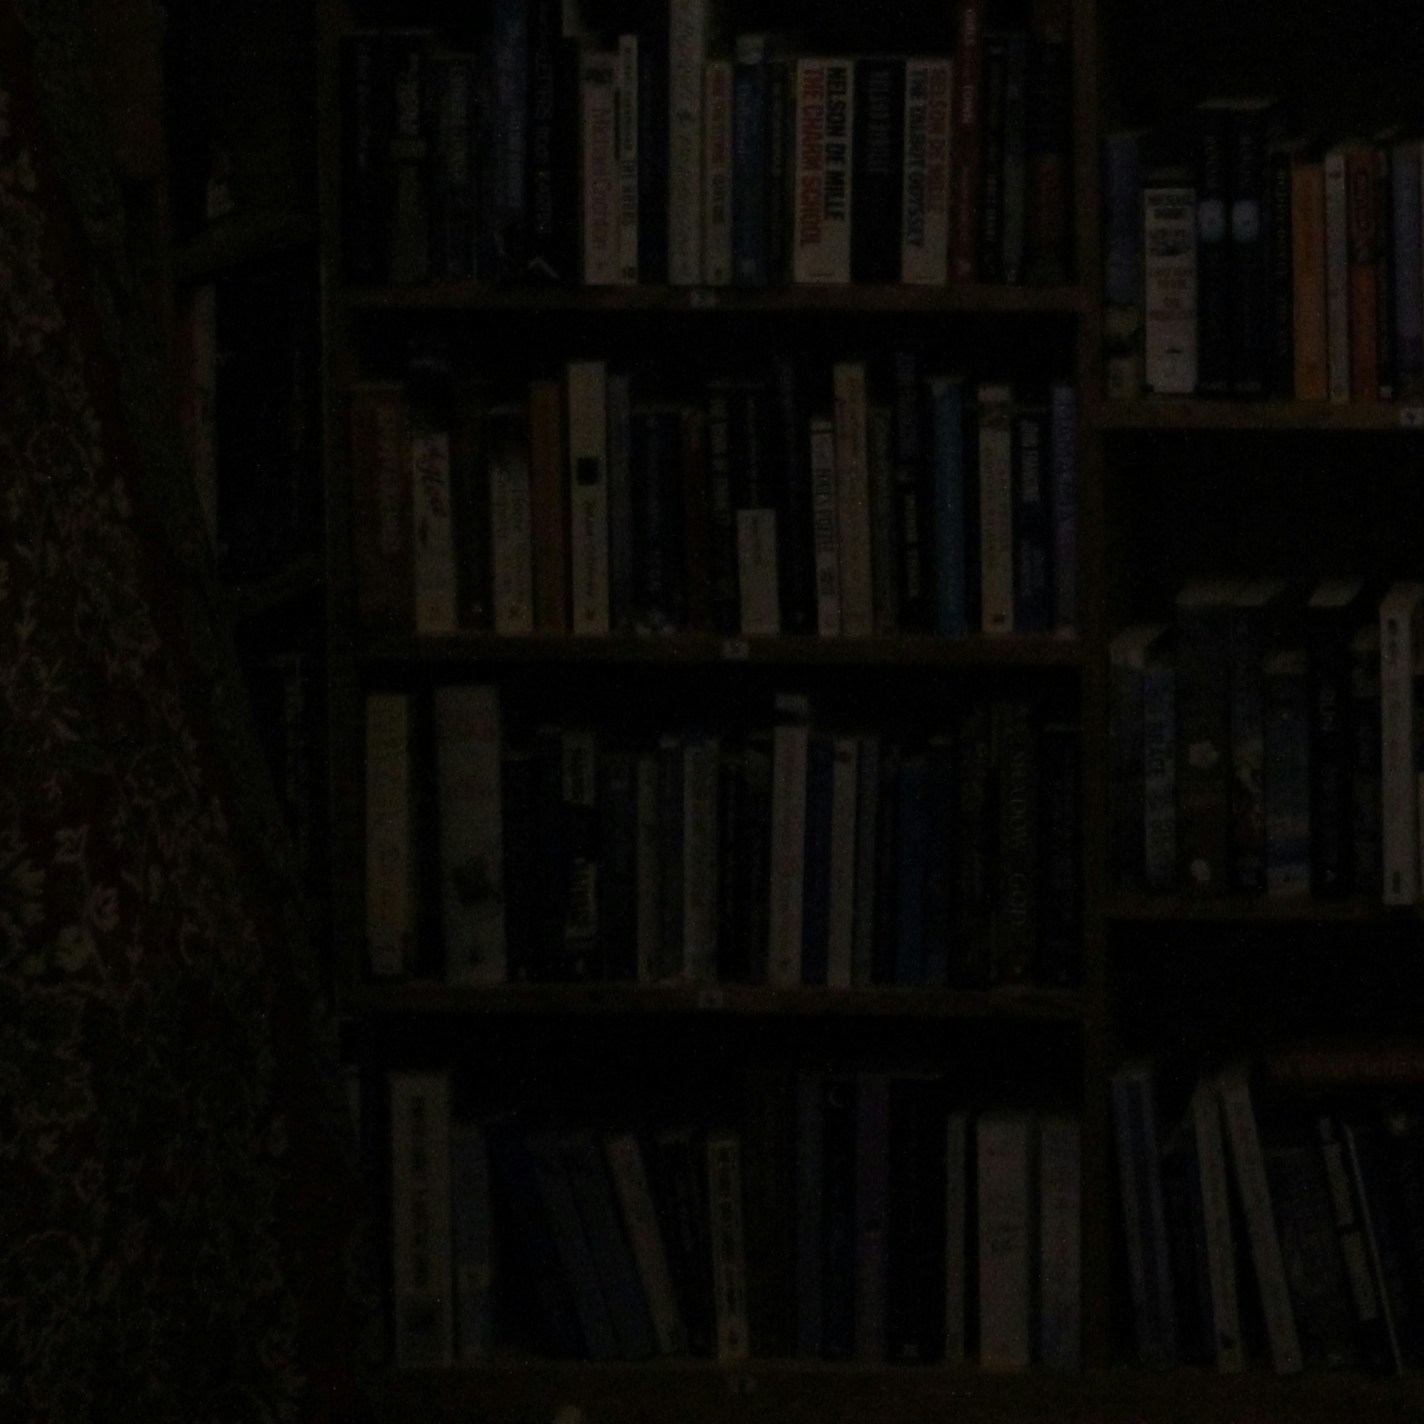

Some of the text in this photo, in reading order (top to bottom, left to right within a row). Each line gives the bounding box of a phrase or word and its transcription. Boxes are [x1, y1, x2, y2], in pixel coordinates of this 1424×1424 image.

[591, 106, 613, 177] Michael
[800, 67, 823, 248] THE CHARM SCHOOL
[824, 66, 847, 222] NELSON DE MILLE
[907, 67, 927, 247] THE TALBOT ODYSSEY
[927, 67, 948, 213] NELSON DE MILLE
[1008, 749, 1028, 926] SHADOW GOD
